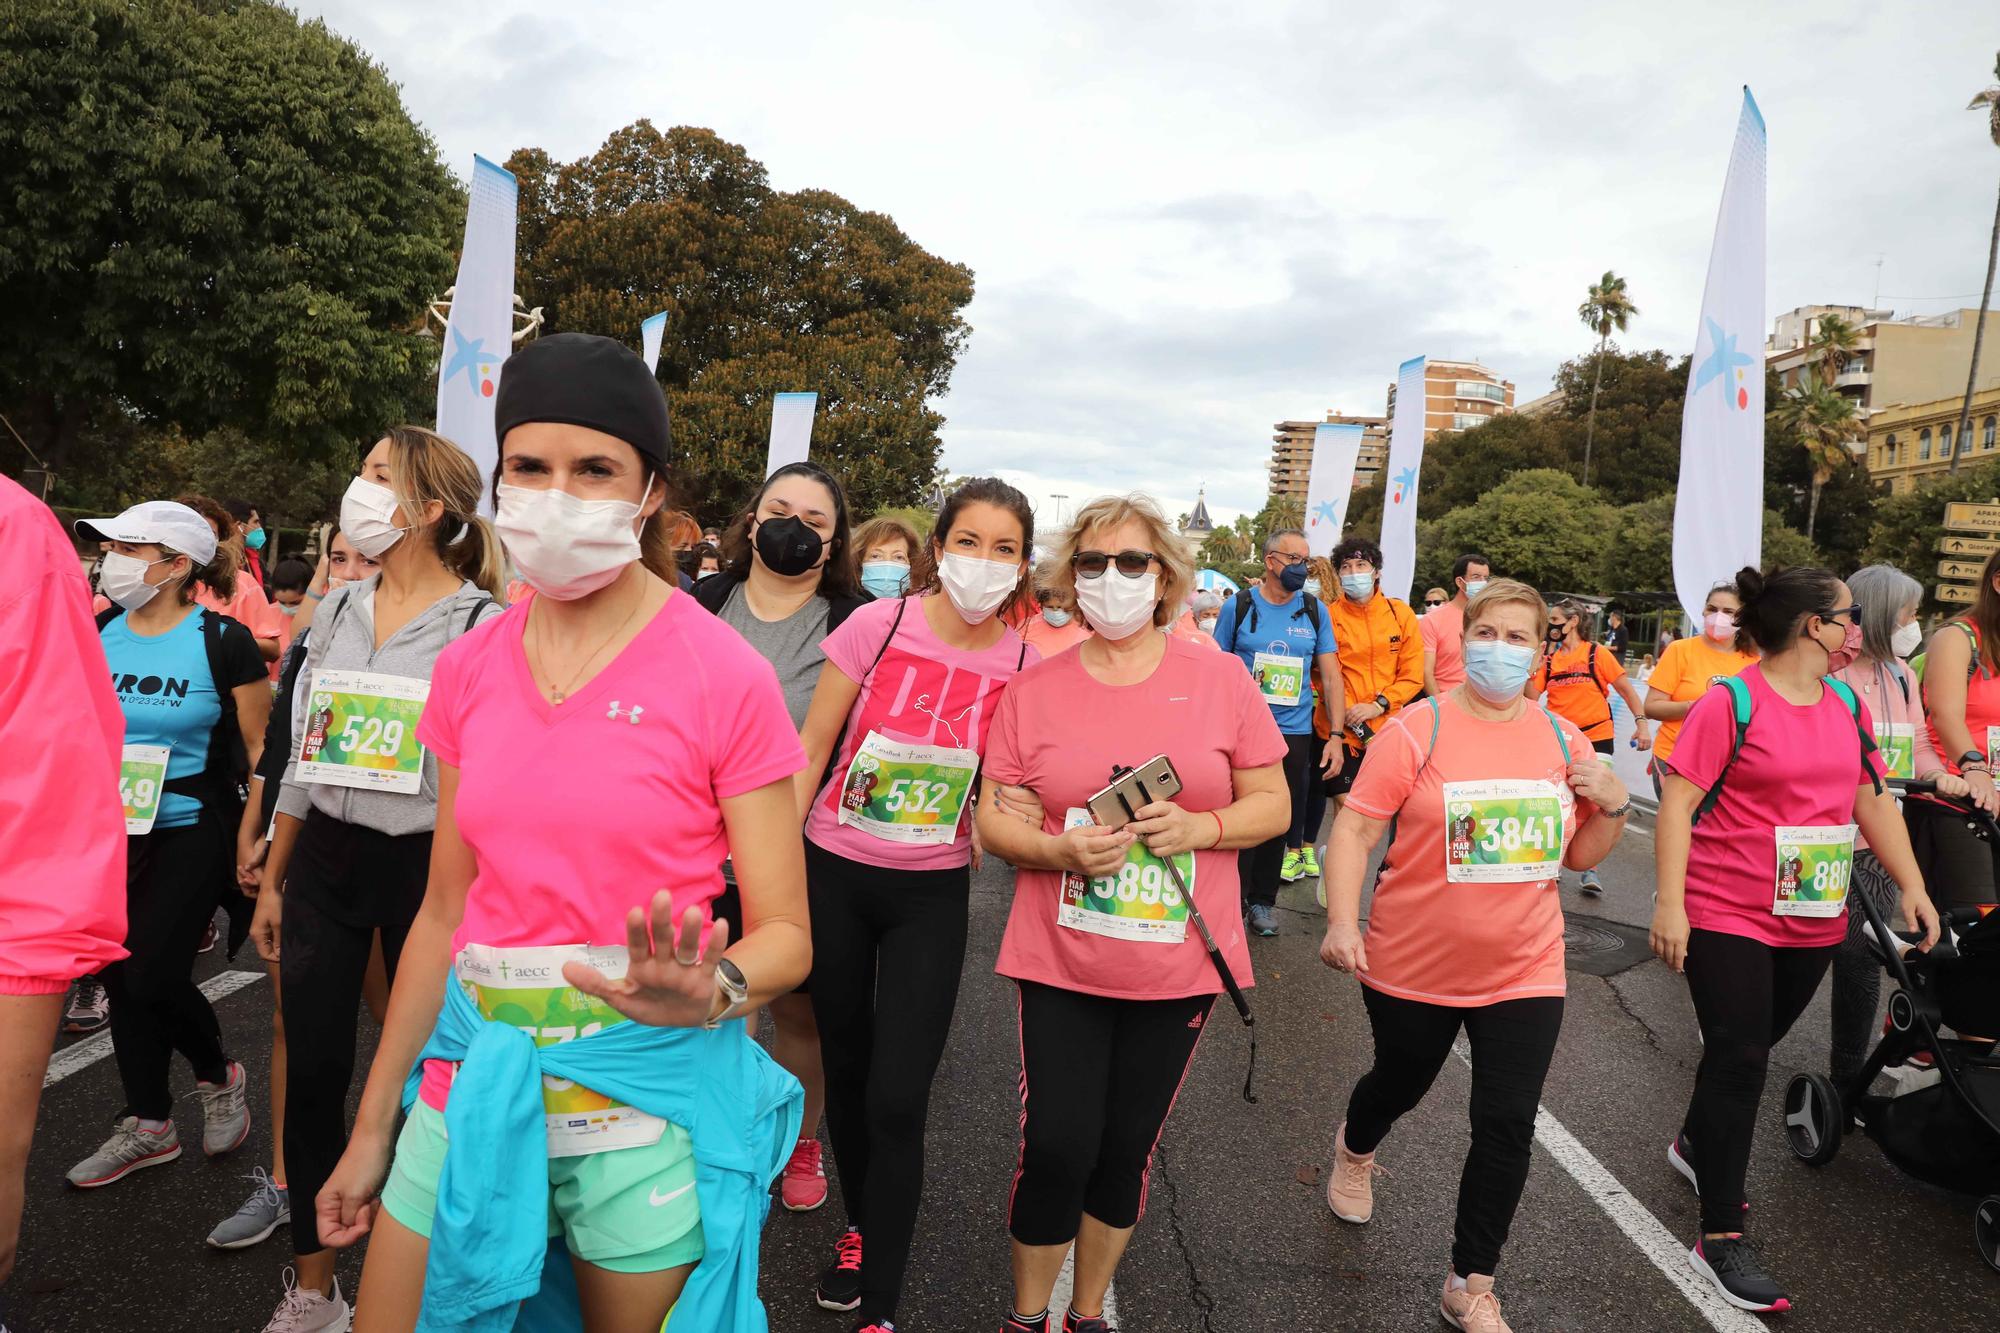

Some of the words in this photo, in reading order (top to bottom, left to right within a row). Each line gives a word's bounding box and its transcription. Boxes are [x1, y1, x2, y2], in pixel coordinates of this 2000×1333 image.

[1270, 673, 1295, 692] 979
[307, 736, 323, 746] MAR
[339, 715, 404, 757] 529
[306, 746, 320, 755] CHA
[848, 792, 866, 804] MAR
[886, 778, 950, 813] 532
[847, 799, 864, 809] CHA
[1480, 816, 1555, 852] 3841
[1452, 841, 1470, 851] MAR
[1452, 850, 1470, 859] CHA
[1068, 879, 1085, 892] MAR
[1093, 862, 1185, 907] 5899
[1781, 880, 1796, 889] MAR
[1068, 889, 1084, 900] CHA
[515, 966, 550, 977] aecc
